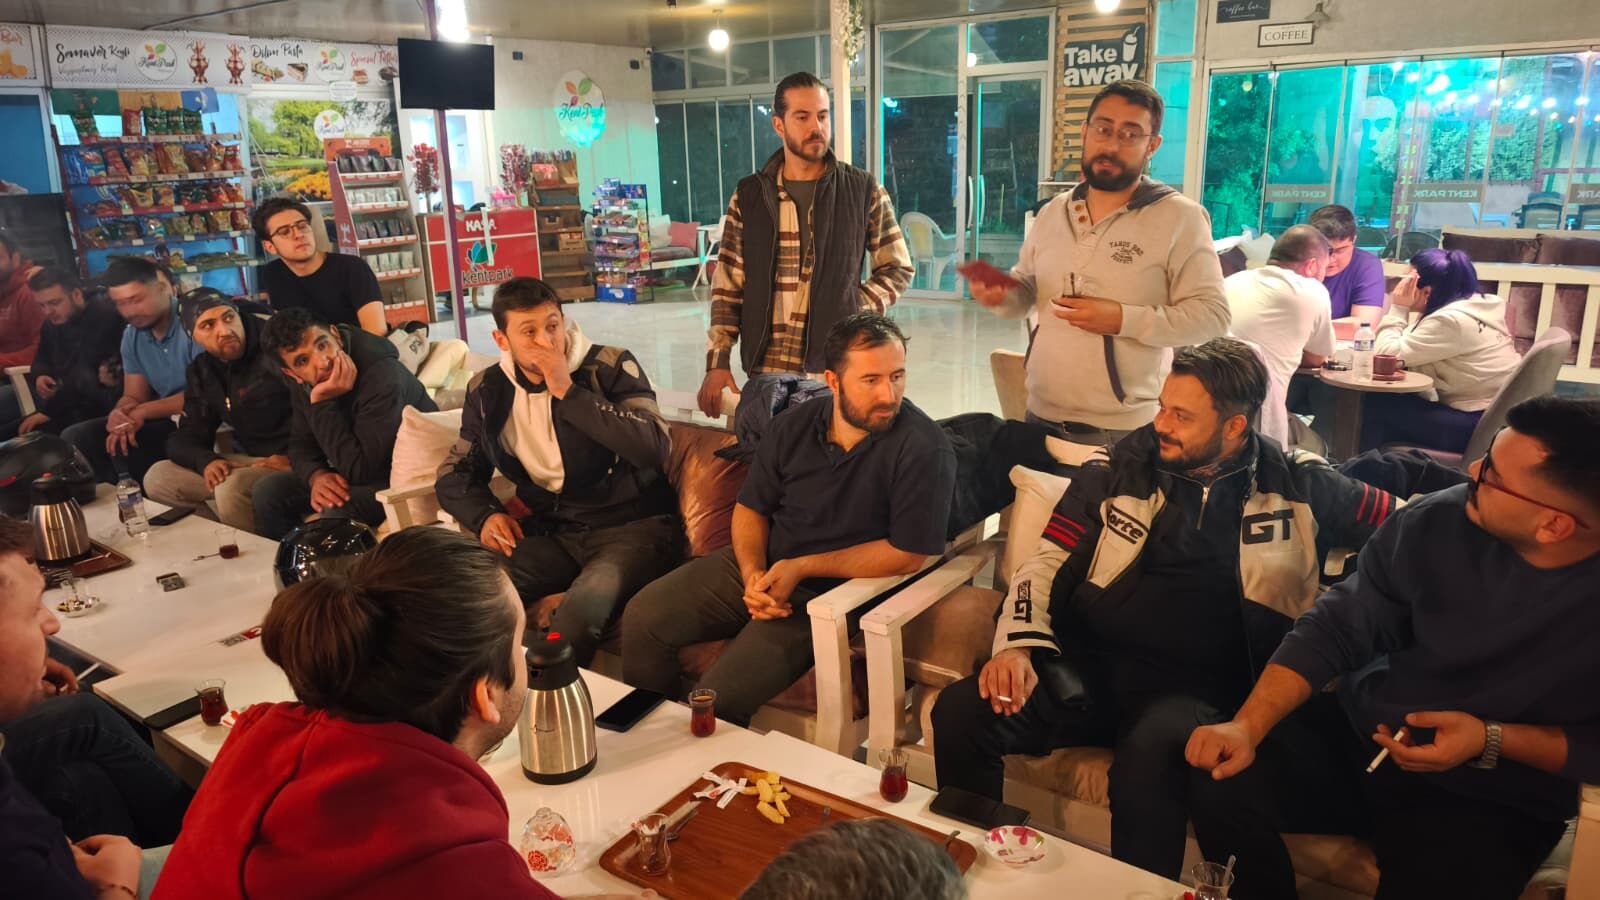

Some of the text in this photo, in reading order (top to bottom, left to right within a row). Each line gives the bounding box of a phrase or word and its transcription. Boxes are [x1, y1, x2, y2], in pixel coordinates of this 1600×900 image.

[1264, 30, 1309, 41] COFFEE
[280, 42, 303, 59] Pasta
[1064, 44, 1118, 67] Take
[1063, 63, 1138, 87] away
[1107, 509, 1144, 539] orte
[1242, 509, 1294, 545] GT
[1013, 600, 1032, 624] GT
